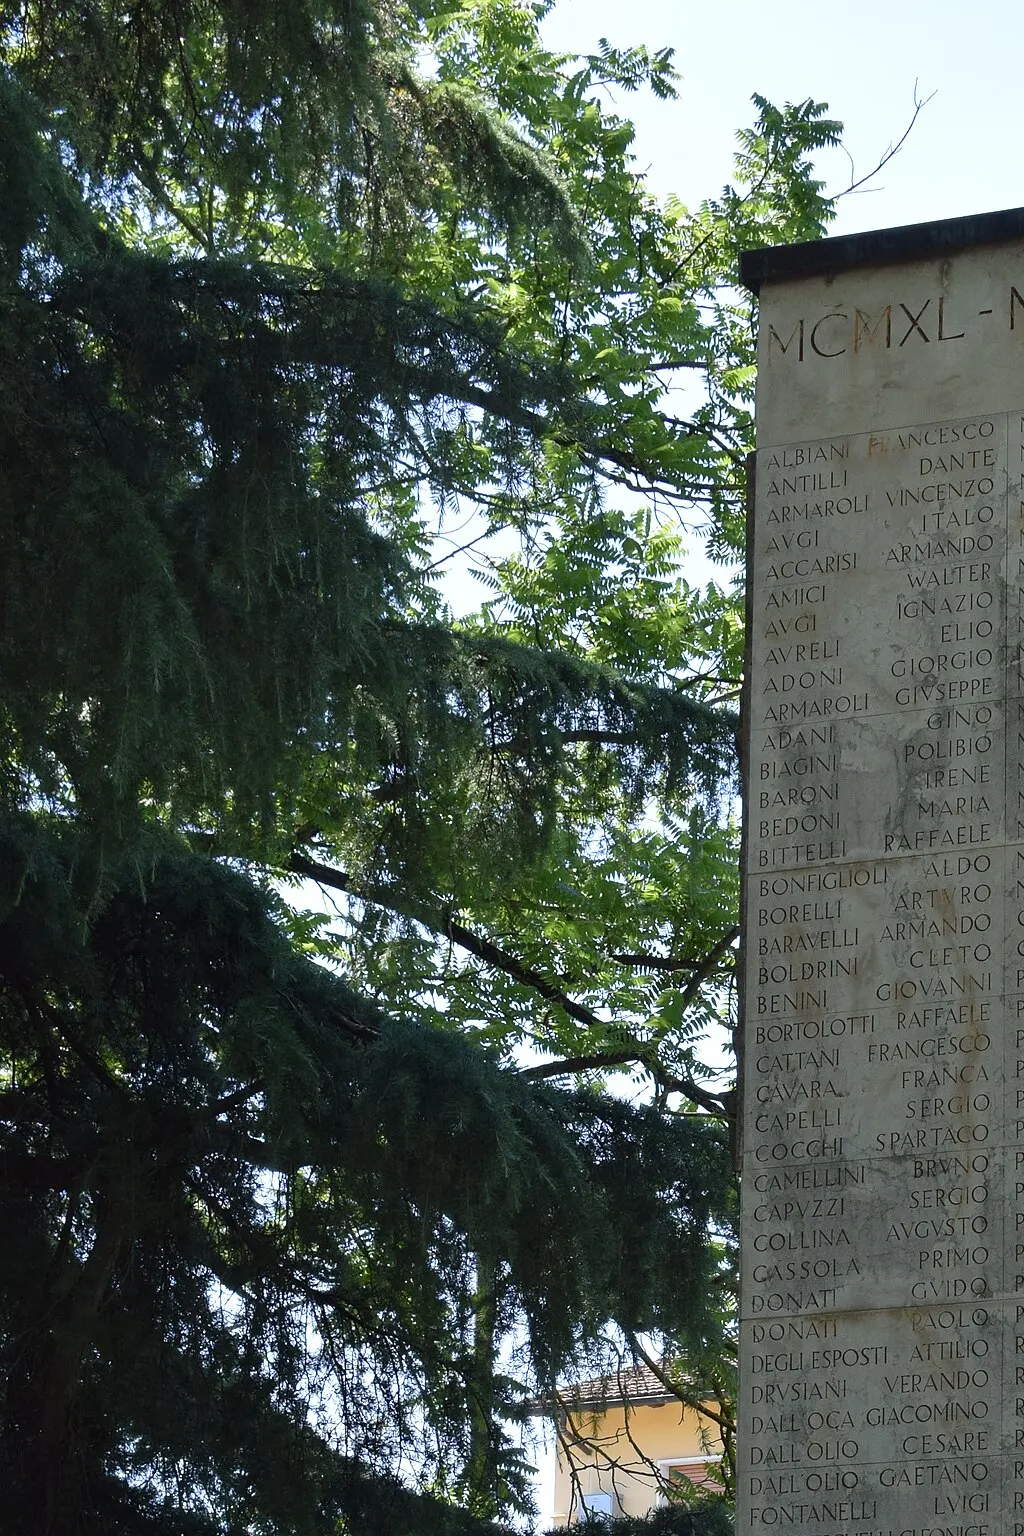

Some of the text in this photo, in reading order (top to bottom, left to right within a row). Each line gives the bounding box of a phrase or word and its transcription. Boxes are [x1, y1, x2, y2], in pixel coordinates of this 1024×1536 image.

[768, 297, 964, 365] MCMXL
[767, 447, 993, 500] ANTILLI DANTE
[765, 475, 993, 528] ARMAROLI VINCENZO
[765, 504, 993, 555] AVGI ITALO
[765, 530, 993, 584] ACCARISI ARMANDO
[765, 560, 991, 611] AMICI WALTER
[763, 617, 992, 669] AVRELI ELIO
[760, 733, 990, 781] BIAGINI POLIBIO
[758, 912, 991, 958] BARAVELLI ARMANDO
[757, 942, 991, 988] BOLDRINI CLETO
[757, 970, 991, 1016] BENINI GIOVANNI
[756, 1030, 990, 1075] CATTANI FRANCESCO
[755, 1092, 990, 1135] CAPELLI SERGIO
[754, 1183, 988, 1224] CAPVZZI SERGIO
[753, 1245, 988, 1285] CASSOLA PRIMO
[751, 1367, 989, 1406] DRVSIANI VERANDO
[902, 1430, 988, 1457] CESARE
[934, 1493, 989, 1516] LVIGI
